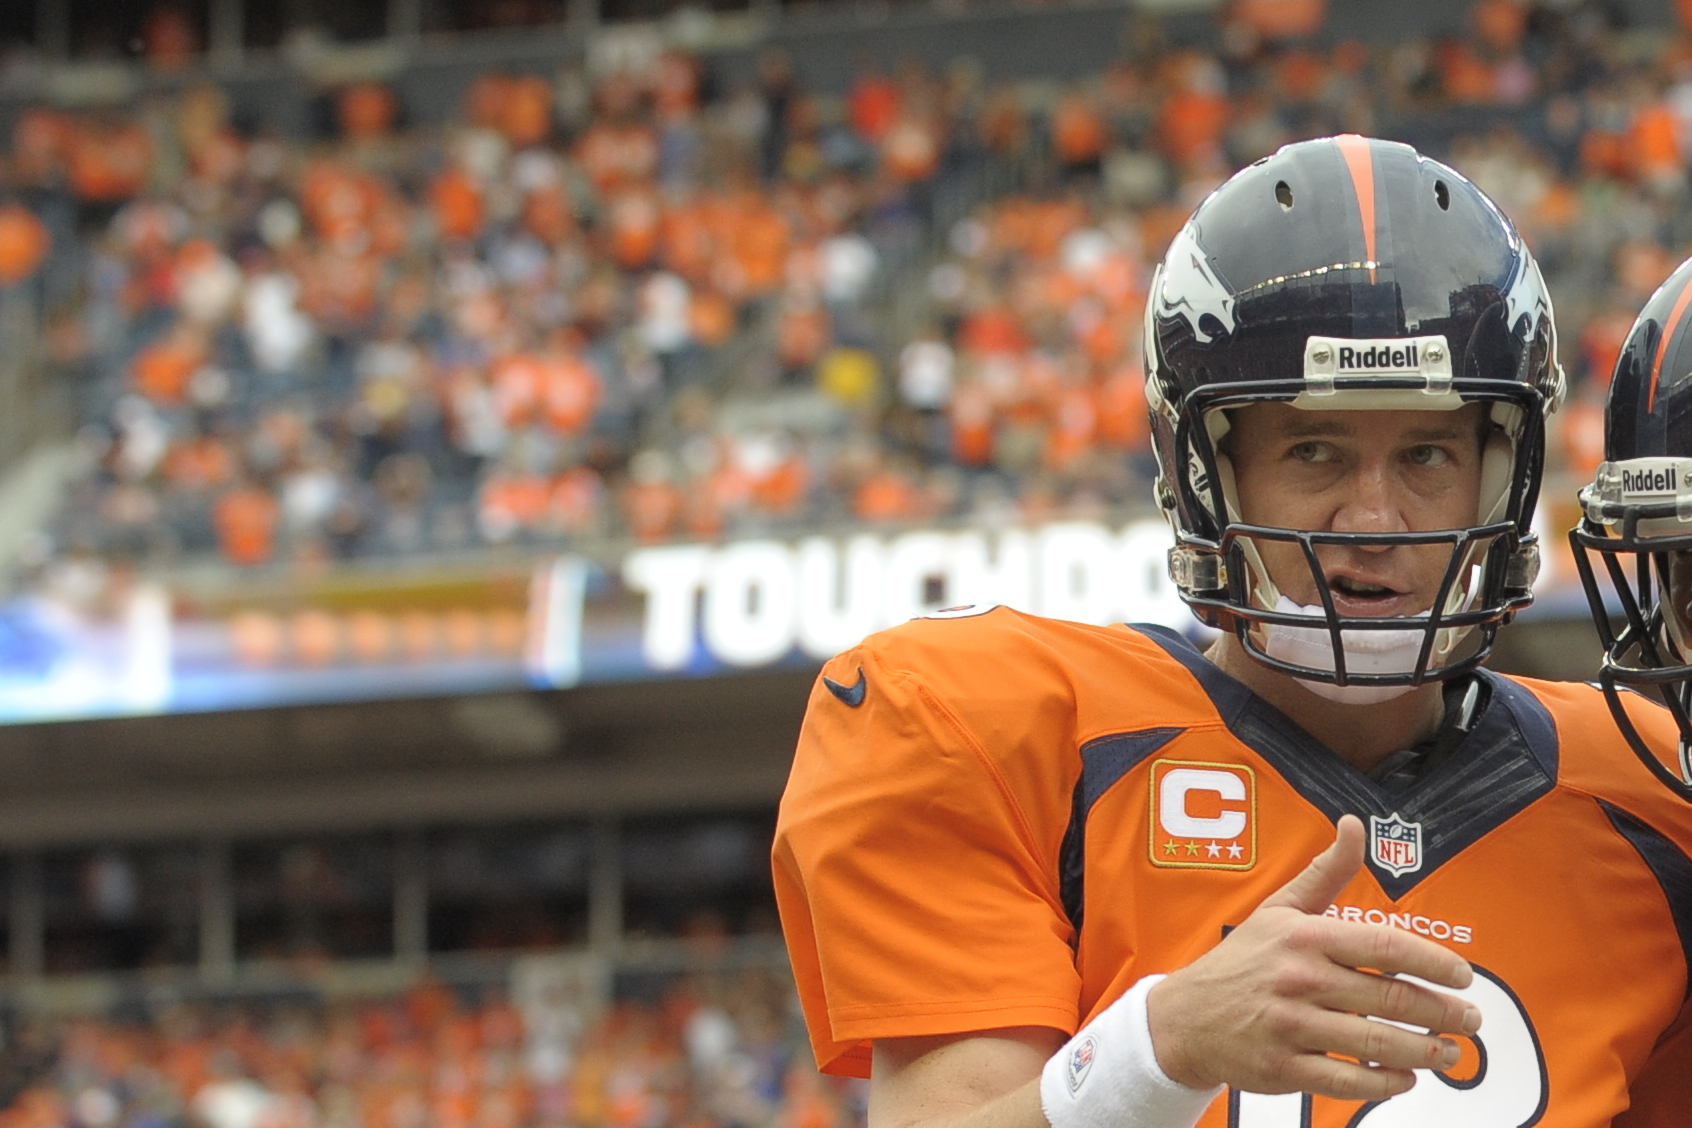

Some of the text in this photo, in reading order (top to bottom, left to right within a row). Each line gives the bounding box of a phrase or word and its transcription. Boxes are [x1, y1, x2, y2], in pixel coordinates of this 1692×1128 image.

[1339, 344, 1419, 369] Riddell
[1622, 467, 1677, 492] Riddell
[1159, 768, 1247, 840] C
[1379, 839, 1414, 866] NFL
